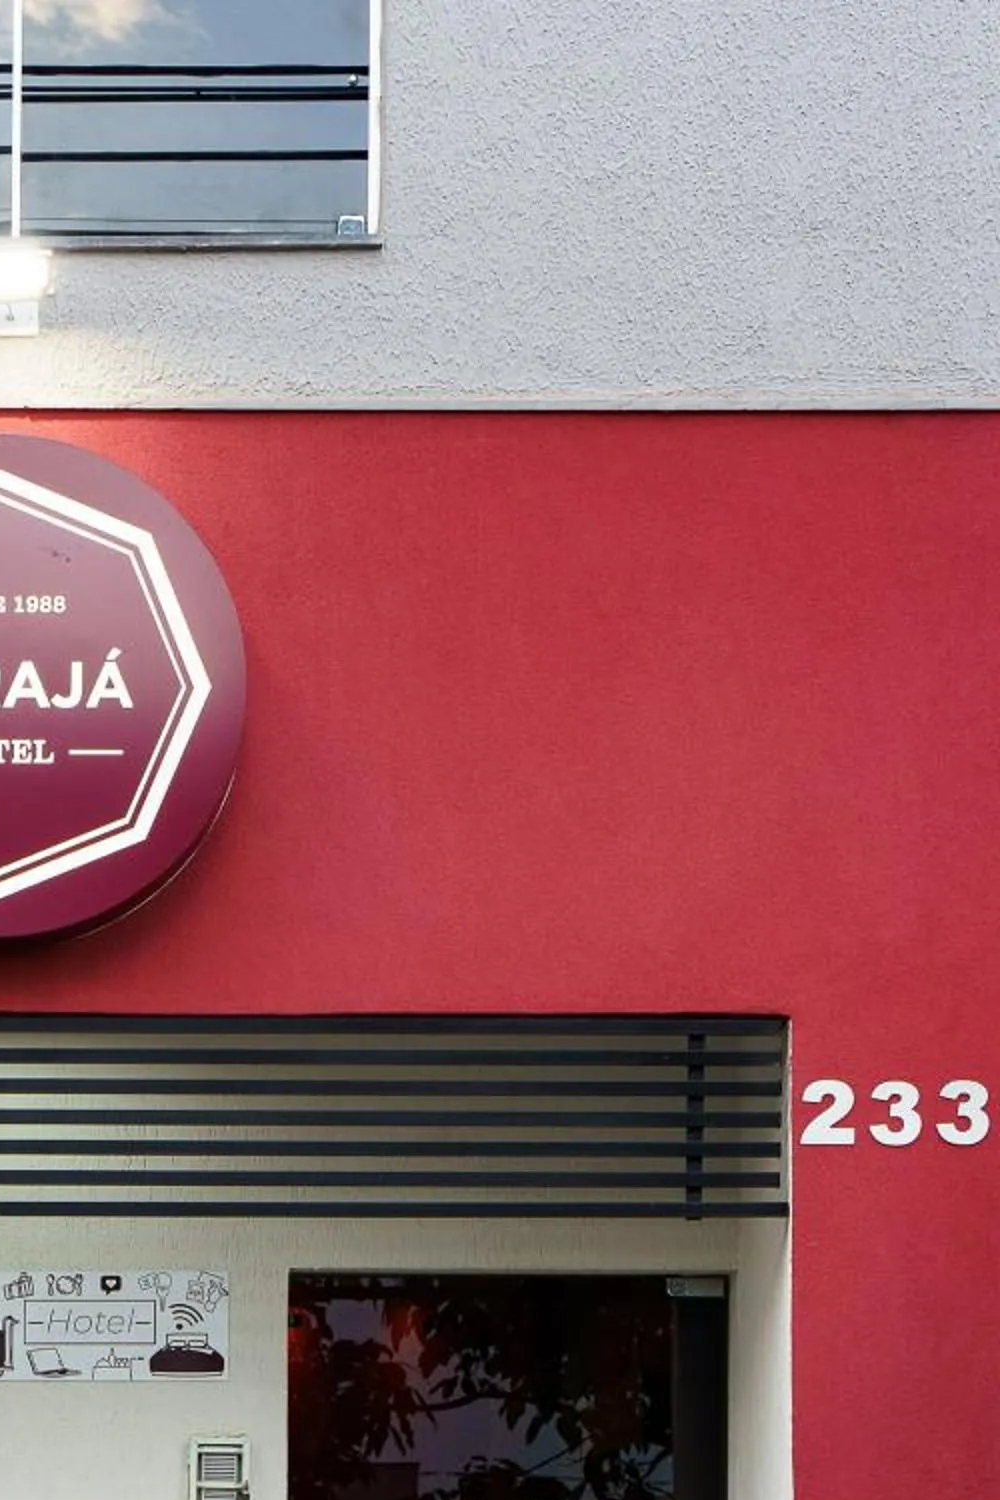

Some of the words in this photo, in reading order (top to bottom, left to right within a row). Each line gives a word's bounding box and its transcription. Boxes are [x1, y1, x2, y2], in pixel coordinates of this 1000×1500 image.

[13, 594, 67, 614] 1988
[799, 1079, 991, 1146] 233
[47, 1308, 135, 1334] Hotel
